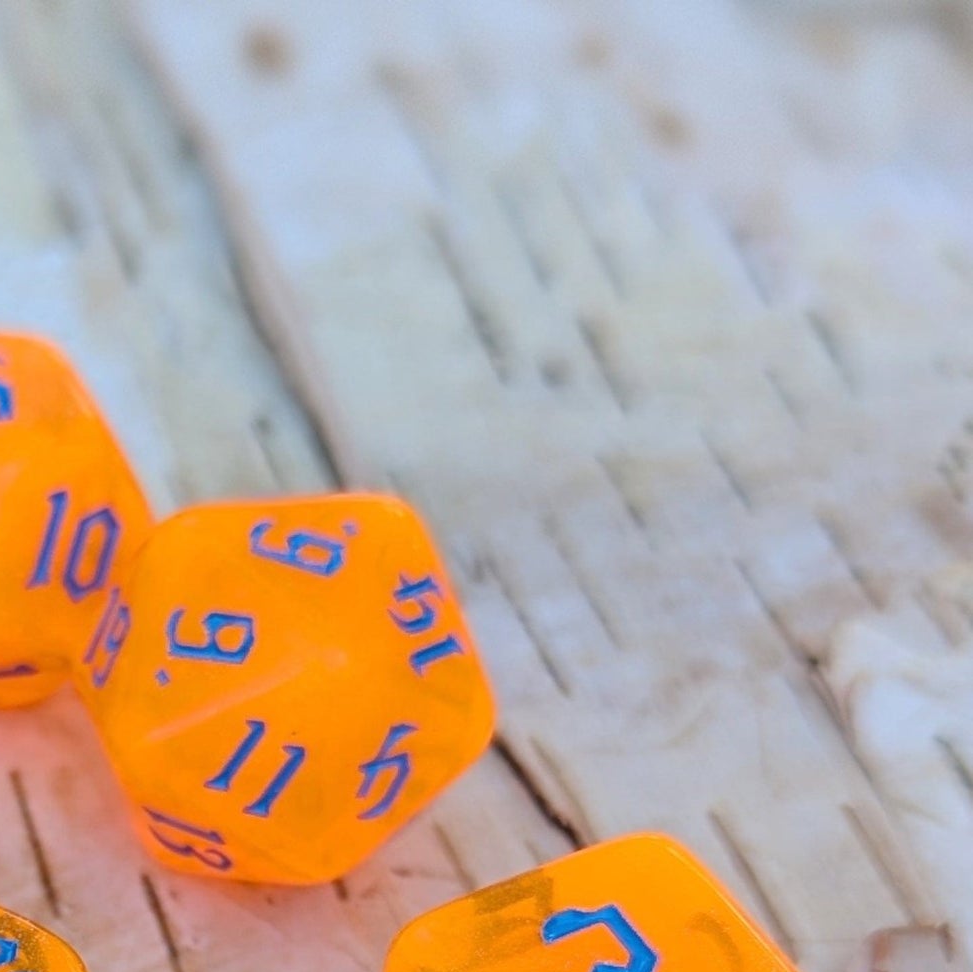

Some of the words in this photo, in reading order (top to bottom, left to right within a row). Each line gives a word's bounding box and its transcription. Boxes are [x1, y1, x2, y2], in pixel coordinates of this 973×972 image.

[26, 490, 121, 602] 10
[388, 573, 464, 677] 14
[203, 719, 306, 818] 11
[355, 723, 417, 820] 4
